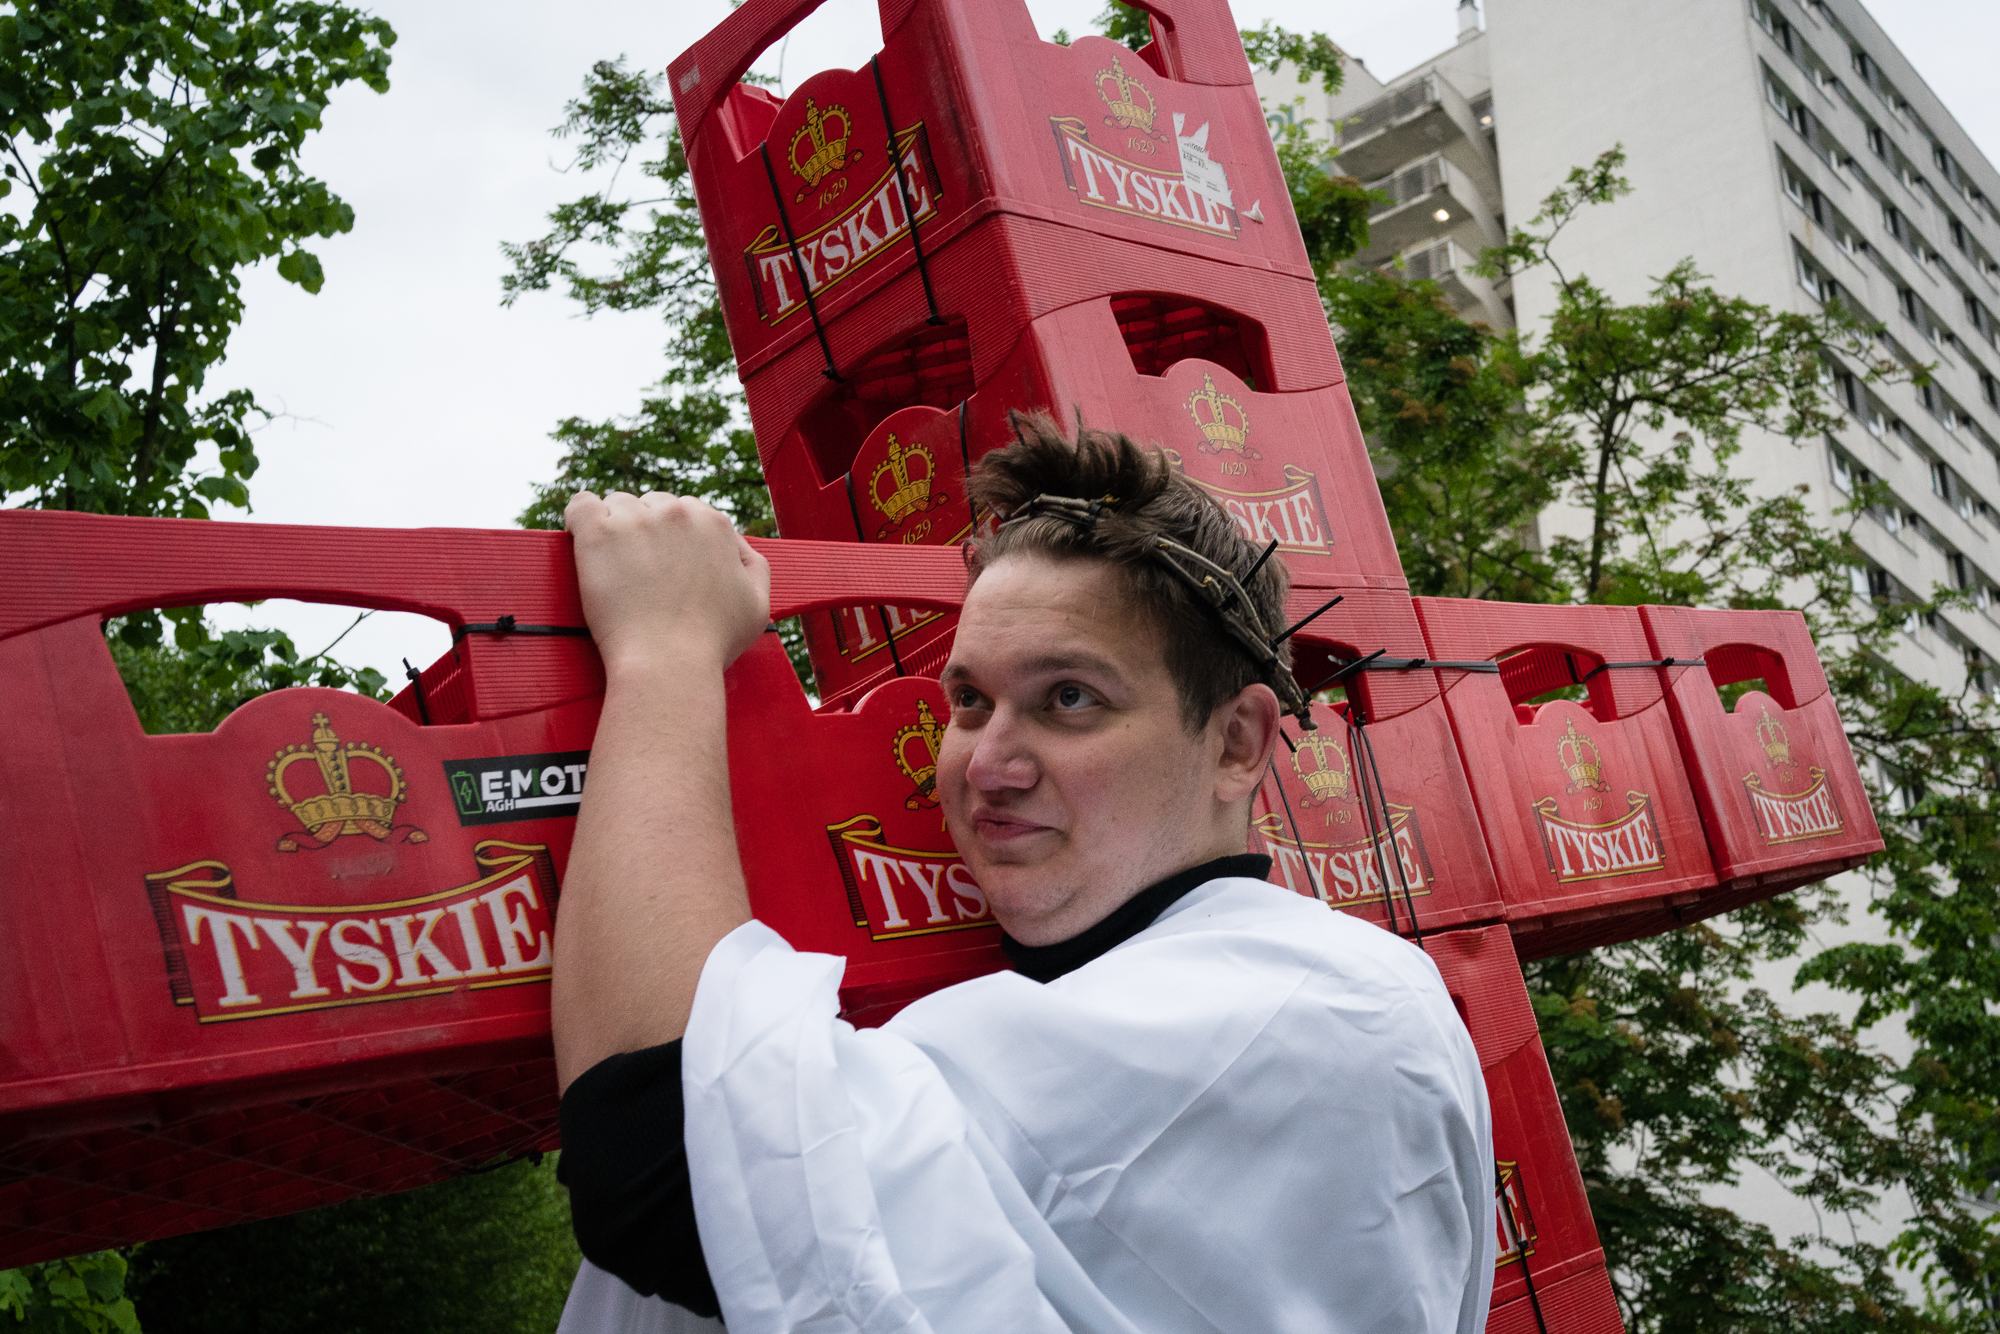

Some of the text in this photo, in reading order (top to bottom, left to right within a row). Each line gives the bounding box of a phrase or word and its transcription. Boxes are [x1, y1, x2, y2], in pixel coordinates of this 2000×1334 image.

[1127, 137, 1156, 155] 1629
[818, 177, 848, 210] 1629
[1066, 137, 1232, 232] TYSKIE
[759, 149, 931, 314] TYSKIE
[1220, 462, 1248, 477] 1629
[902, 519, 932, 545] 1629
[480, 764, 587, 802] E-MOT
[485, 799, 516, 813] AGH
[1325, 810, 1352, 826] 1629
[1583, 796, 1604, 811] 1629
[1752, 783, 1840, 839] TYSKIE
[1544, 810, 1660, 876] TYSKIE
[1265, 826, 1426, 902] TYSKIE
[853, 849, 989, 930] TYS
[182, 874, 553, 1008] TYSKIE
